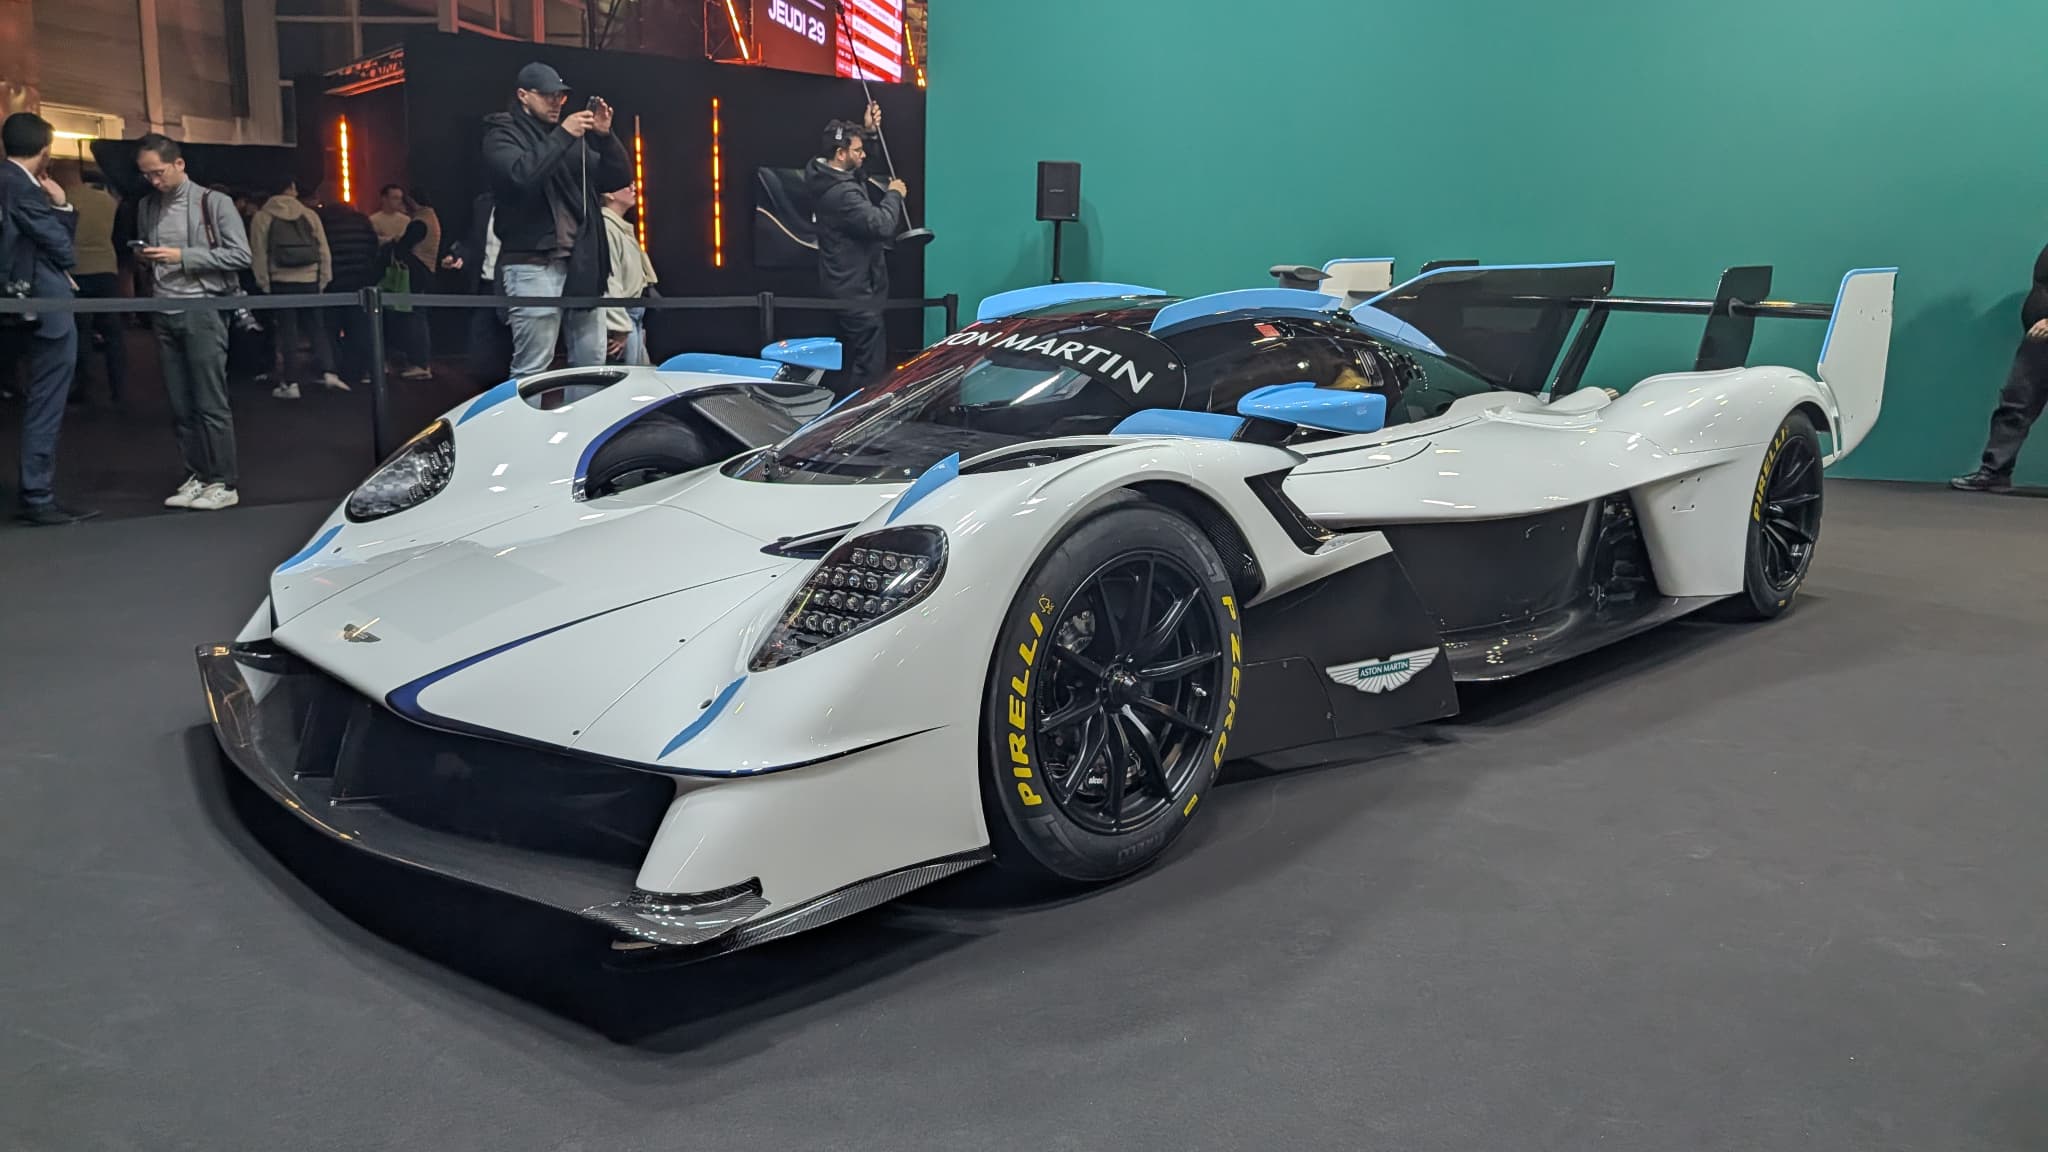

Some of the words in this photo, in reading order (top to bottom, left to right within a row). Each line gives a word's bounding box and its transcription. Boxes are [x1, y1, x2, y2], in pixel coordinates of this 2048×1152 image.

[768, 0, 806, 36] JEUDI
[808, 16, 825, 45] 29
[992, 334, 1153, 394] MARTIN
[1753, 428, 1787, 522] PIRELLI
[1213, 632, 1241, 769] ZERO
[1360, 666, 1383, 677] ASTON
[1384, 661, 1409, 673] MARTIN
[1008, 612, 1044, 806] PIRELLI
